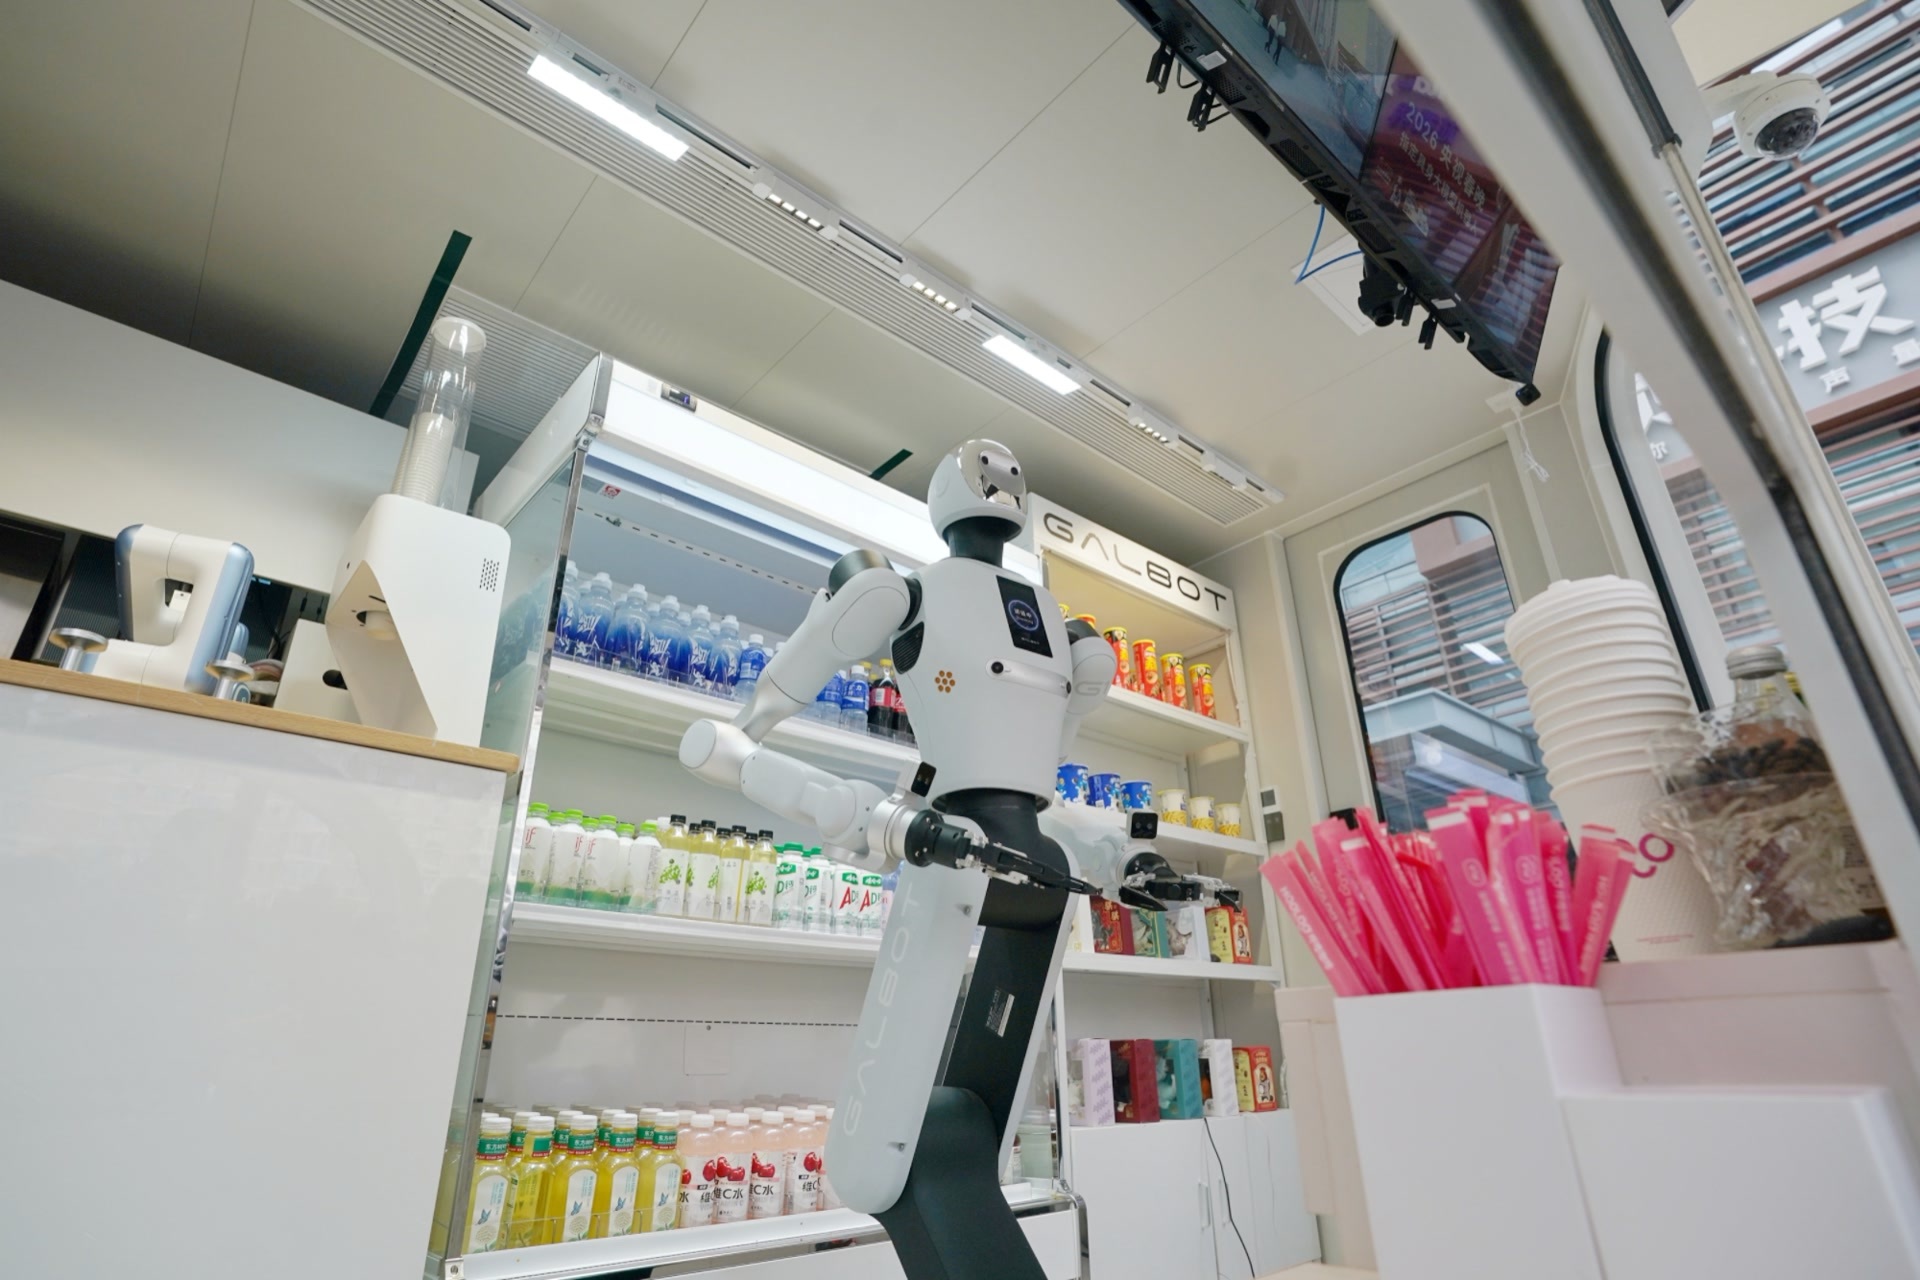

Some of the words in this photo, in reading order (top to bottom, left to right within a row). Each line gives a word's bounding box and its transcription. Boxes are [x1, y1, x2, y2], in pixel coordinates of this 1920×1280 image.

[1405, 101, 1439, 150] 2026
[1440, 143, 1486, 212] 央视春晚
[1043, 511, 1227, 612] GALBOT
[525, 826, 536, 845] if
[575, 835, 583, 853] if
[587, 837, 596, 856] if
[843, 883, 921, 1137] GALBOT
[713, 1187, 743, 1200] 维C水
